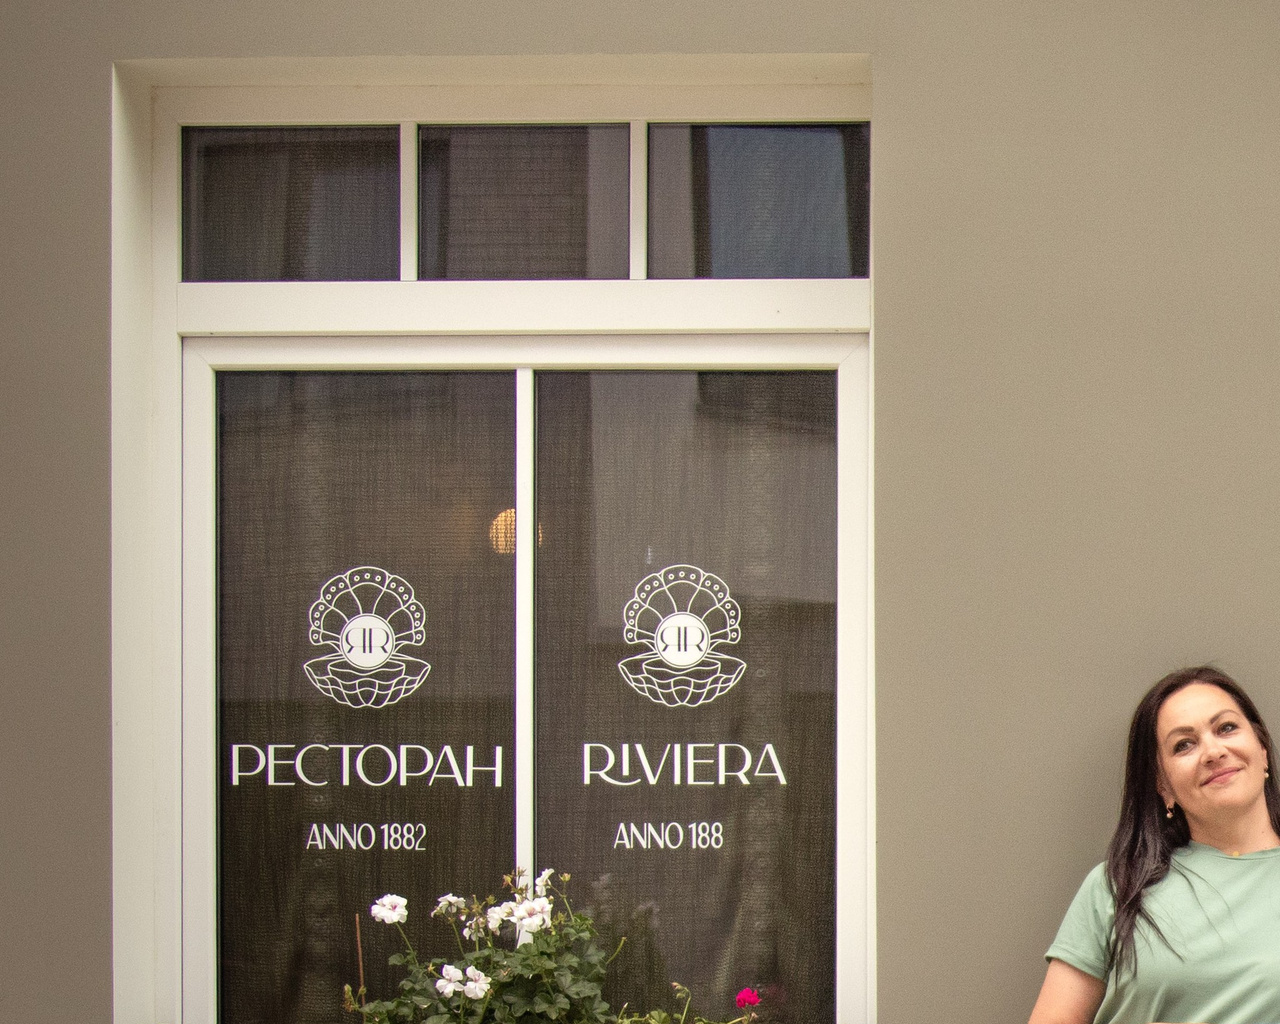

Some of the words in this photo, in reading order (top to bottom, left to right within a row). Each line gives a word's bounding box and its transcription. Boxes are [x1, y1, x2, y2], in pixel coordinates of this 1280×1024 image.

[231, 743, 503, 788] РЕСТОРАН
[583, 743, 788, 786] RIVIERA
[306, 823, 376, 850] ANNO
[380, 823, 427, 851] 1882
[613, 821, 684, 849] ANNO
[687, 821, 724, 850] 188
